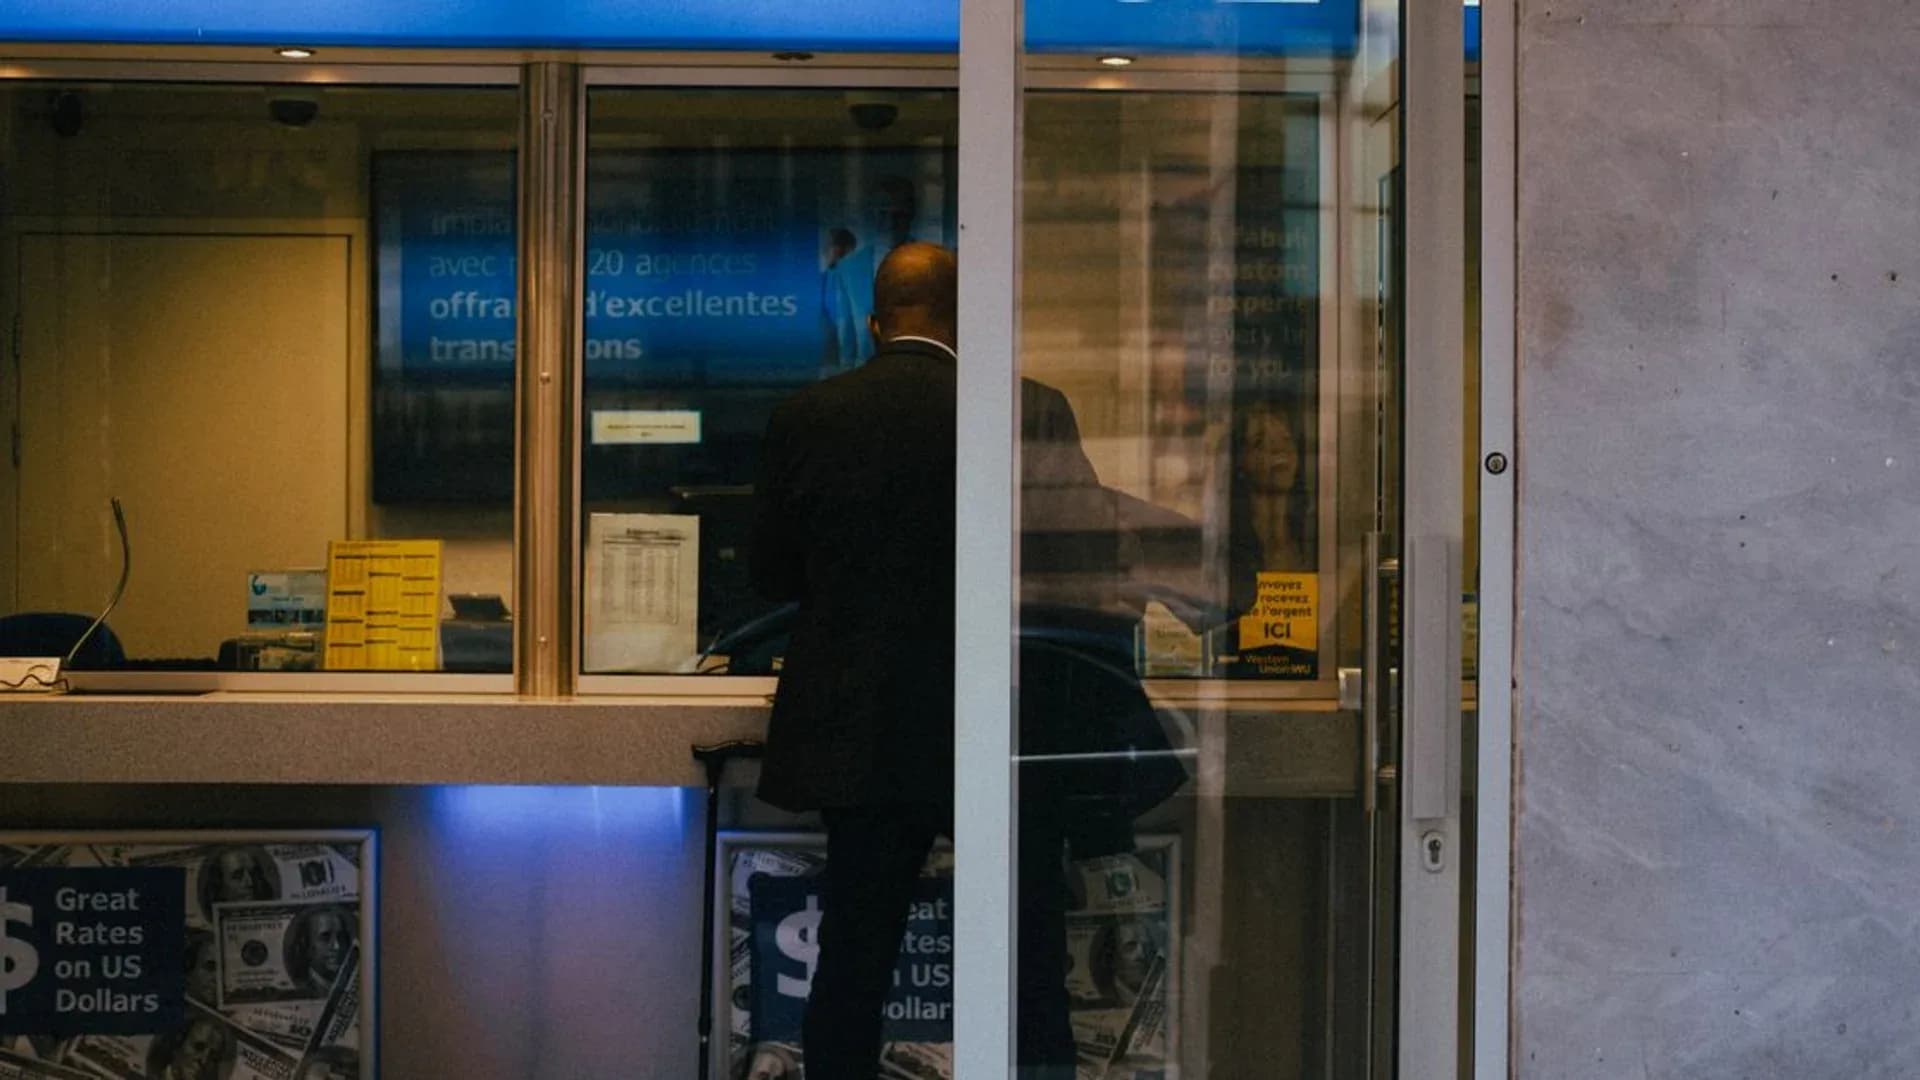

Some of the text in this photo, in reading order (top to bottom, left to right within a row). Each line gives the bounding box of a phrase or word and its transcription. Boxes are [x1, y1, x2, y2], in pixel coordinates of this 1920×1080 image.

[430, 255, 497, 278] avec
[430, 290, 514, 319] offra
[1258, 581, 1302, 592] nvoyez
[1263, 622, 1291, 640] ICI
[56, 887, 139, 911] Great
[56, 921, 144, 945] Rates
[55, 955, 143, 979] on US
[912, 963, 951, 988] US
[56, 988, 160, 1013] Dollars
[881, 995, 953, 1021] ollar
